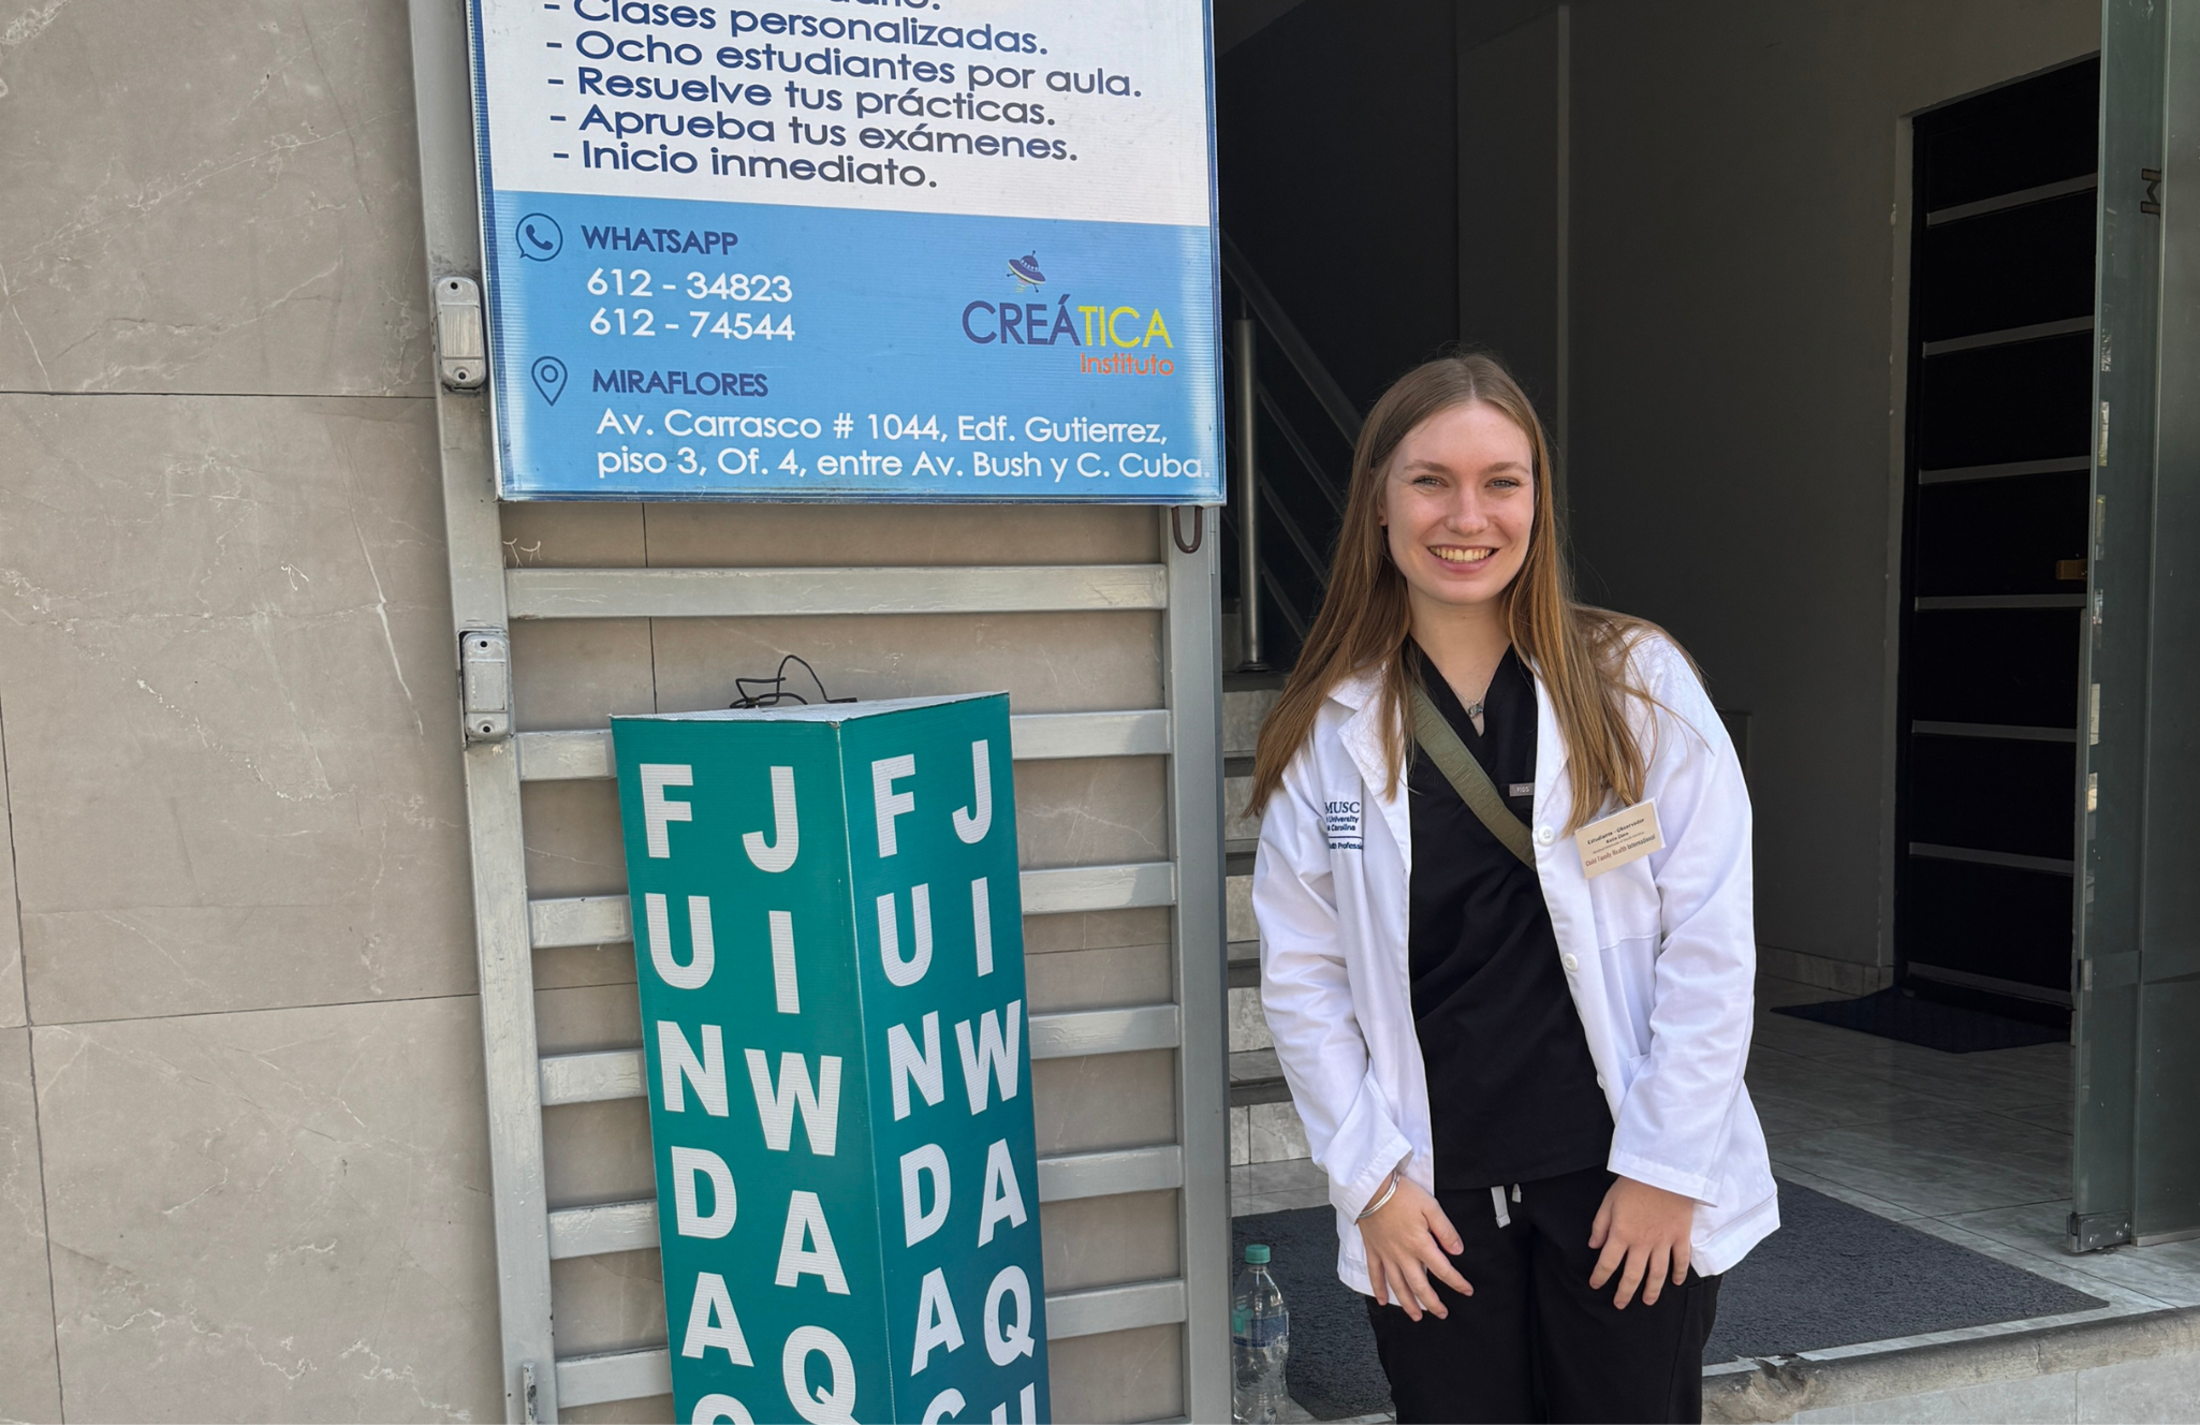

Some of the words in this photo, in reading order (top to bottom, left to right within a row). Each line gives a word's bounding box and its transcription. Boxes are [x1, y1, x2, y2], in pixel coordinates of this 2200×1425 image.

[574, 0, 716, 29] Clases
[731, 9, 1048, 55] personalizadas.
[576, 30, 702, 65] Ocho
[716, 43, 955, 84] estudiantes
[968, 65, 1036, 91] por
[1046, 68, 1142, 97] aula.
[578, 67, 772, 106] Resuelve
[784, 80, 843, 111] tus
[856, 87, 1055, 126] prácticas.
[578, 104, 775, 142] Aprueba
[788, 116, 846, 147] tus
[859, 123, 1078, 161] exámenes.
[583, 141, 698, 174] Inicio
[710, 147, 937, 188] inmediato.
[581, 225, 738, 255] WHATSAPP
[587, 267, 653, 297] 612
[686, 271, 793, 303] 34823
[590, 307, 656, 336] 612
[689, 311, 796, 341] 74544
[962, 294, 1174, 349] CREÁTICA
[592, 369, 769, 397] MIRAFLORES
[1080, 353, 1175, 376] Instituto
[596, 408, 653, 436] Av.
[664, 409, 822, 439] Carrasco
[833, 412, 854, 439] #
[867, 414, 948, 442] 1044,
[958, 415, 1016, 442] Edf.
[1025, 416, 1168, 445] Gutierrez,
[597, 446, 667, 478] piso
[677, 447, 707, 476] 3,
[717, 448, 768, 475] Of.
[778, 449, 807, 477] 4,
[817, 450, 903, 476] entre
[912, 451, 963, 477] Av.
[973, 451, 1042, 477] Bush
[1050, 457, 1068, 483] y
[1076, 452, 1110, 477] C.
[1119, 452, 1210, 478] Cuba.
[1324, 801, 1361, 814] MUSC
